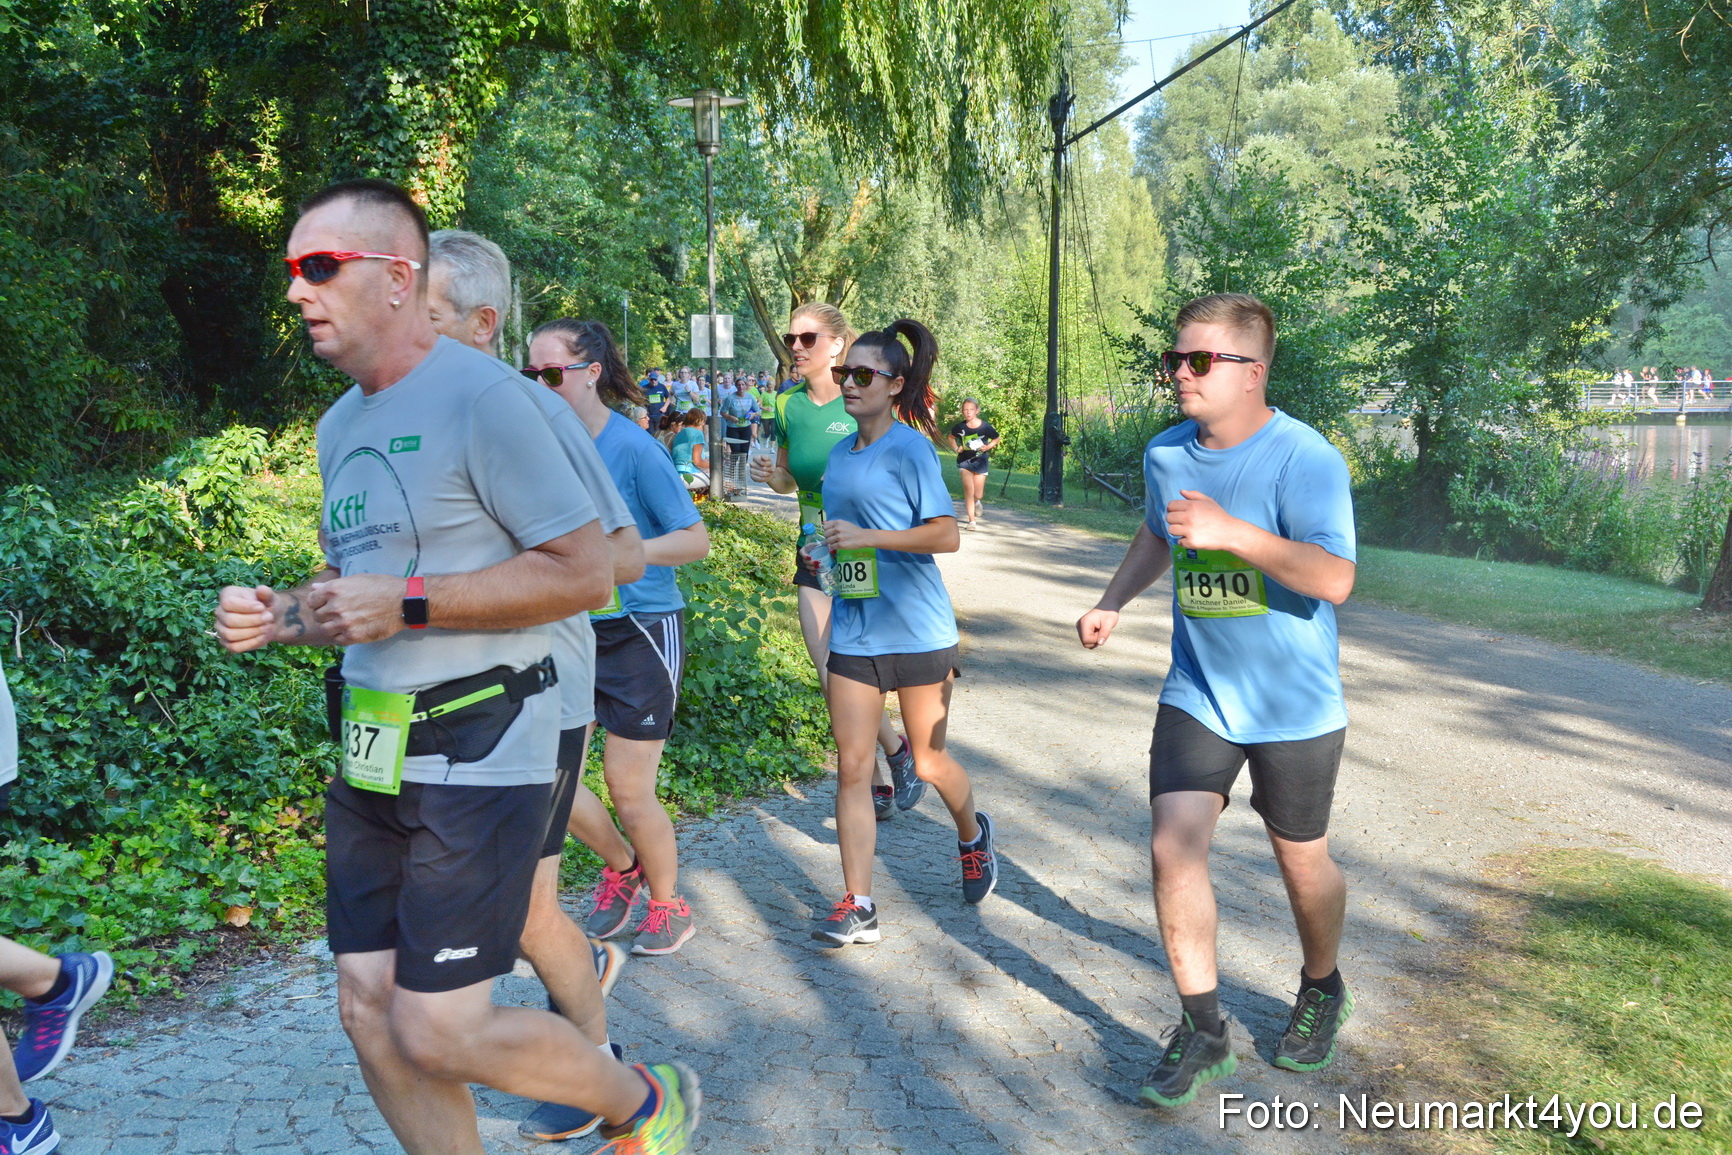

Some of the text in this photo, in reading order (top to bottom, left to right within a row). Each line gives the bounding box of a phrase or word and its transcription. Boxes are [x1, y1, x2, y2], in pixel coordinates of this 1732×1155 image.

[826, 421, 850, 433] AOK
[330, 490, 367, 532] KfH
[1184, 571, 1250, 598] 1810
[1223, 598, 1247, 606] Daniel
